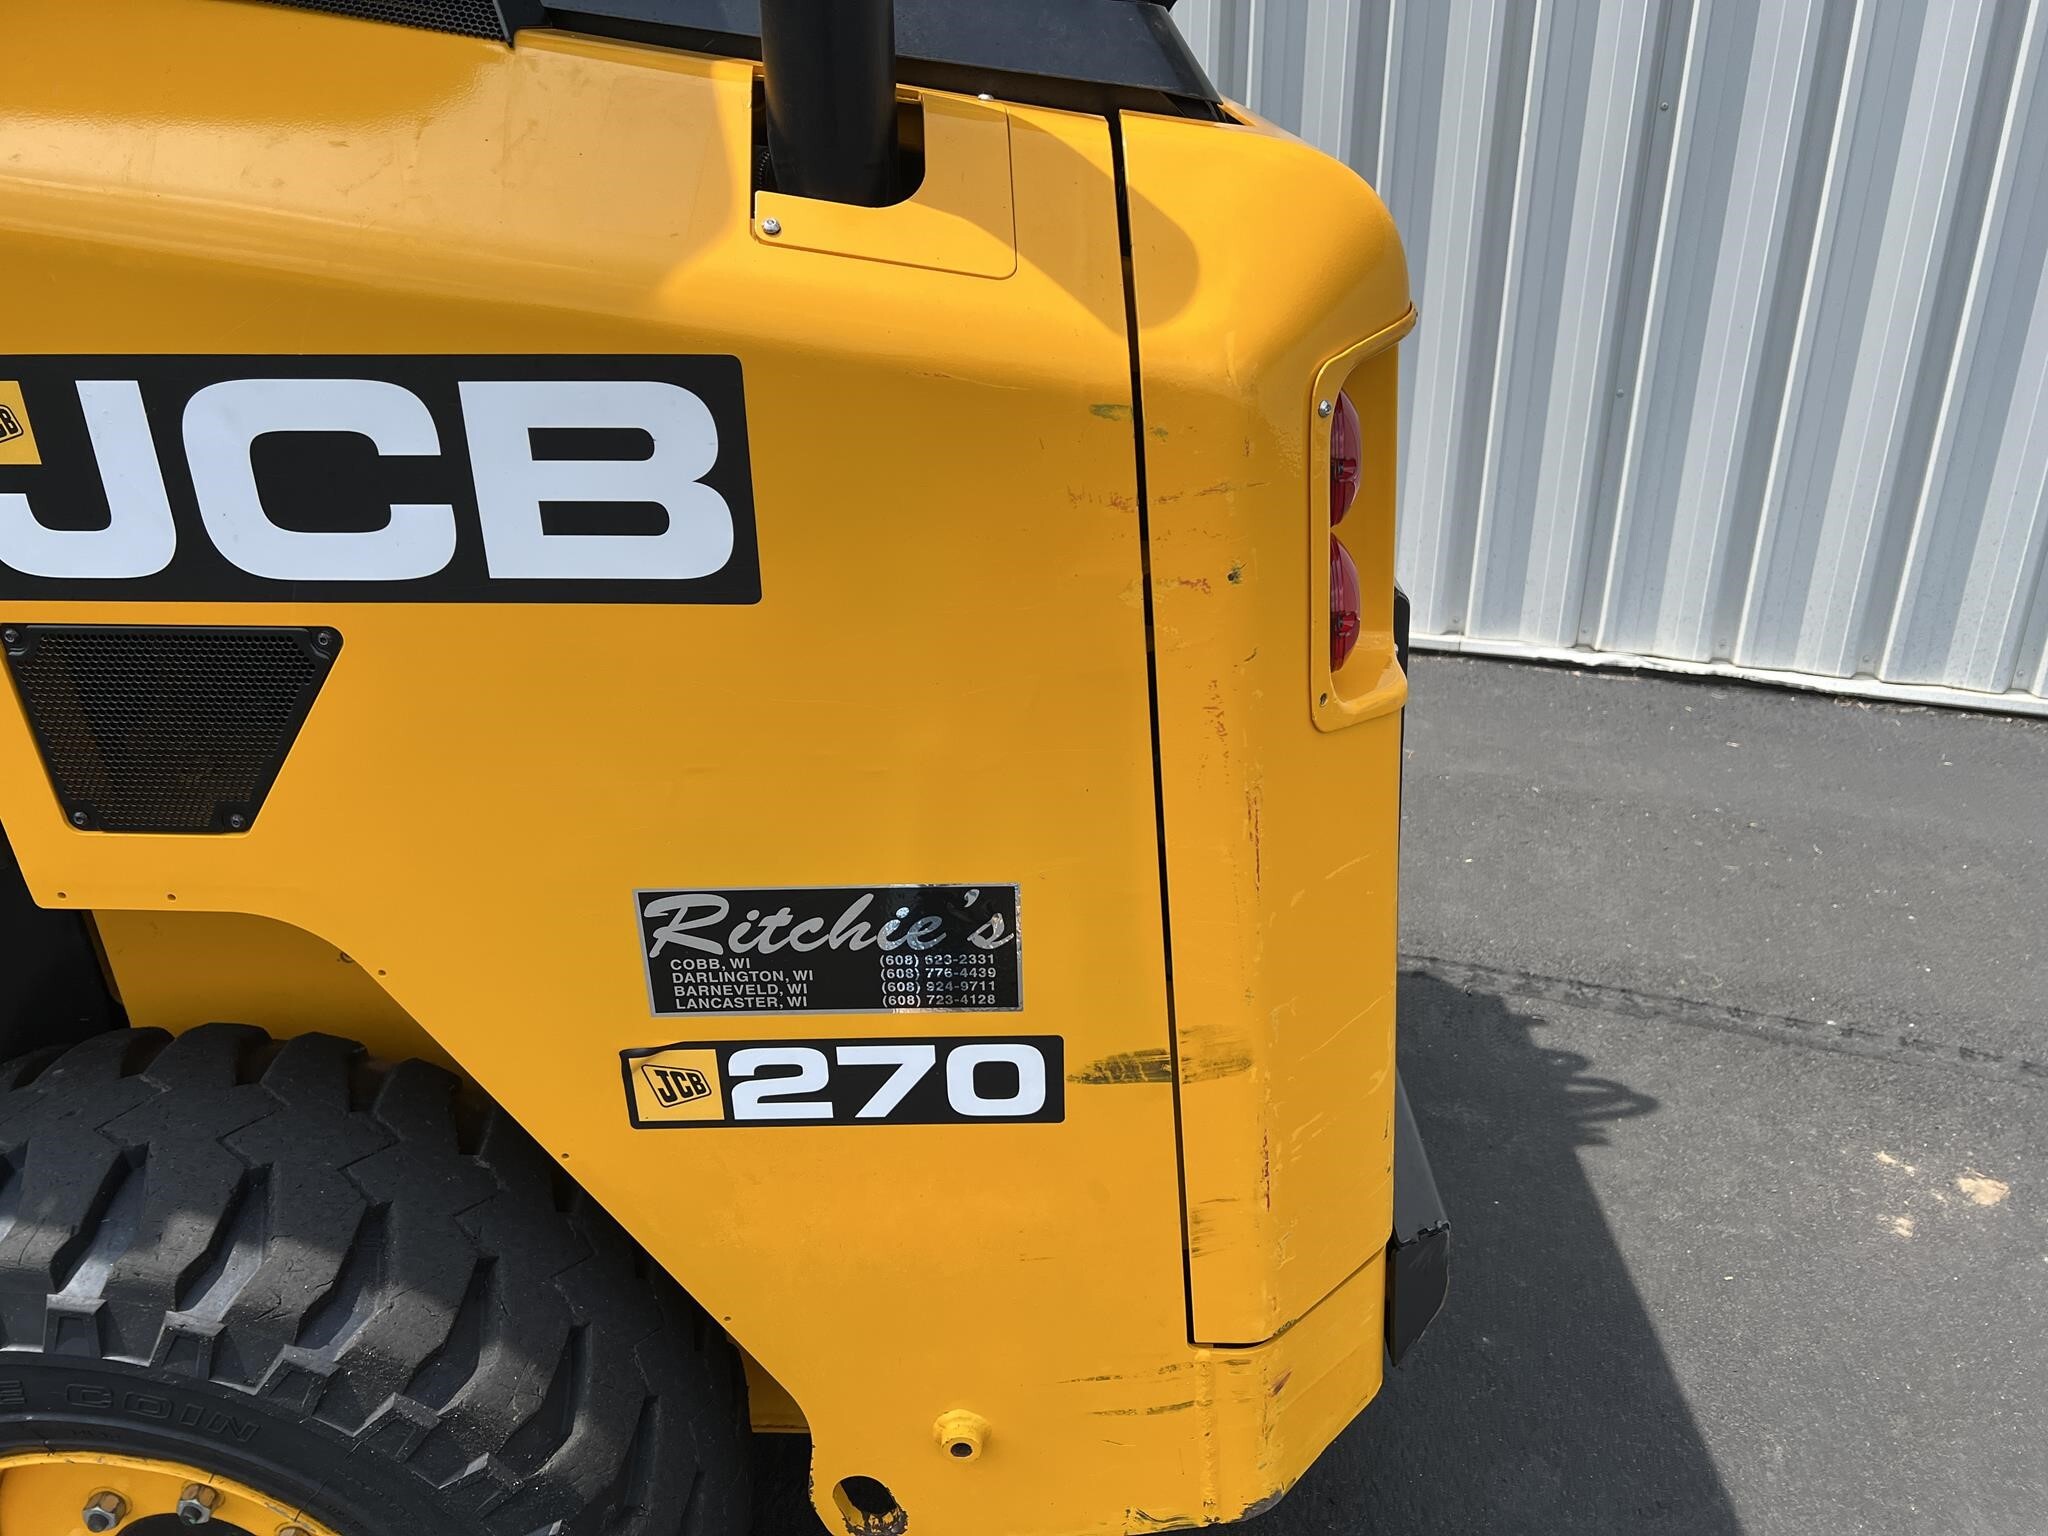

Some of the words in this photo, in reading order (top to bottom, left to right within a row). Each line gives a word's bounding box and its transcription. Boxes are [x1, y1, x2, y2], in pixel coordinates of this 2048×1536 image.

[0, 379, 734, 581] JCB
[644, 889, 1015, 958] Ritchie's
[670, 958, 726, 971] COBB,
[730, 958, 751, 969] WI
[879, 954, 919, 968] (608)
[924, 954, 995, 965] 623-2331
[672, 970, 789, 984] DARLINGTON,
[793, 970, 814, 981] WI
[880, 968, 920, 981] (608)
[925, 967, 997, 979] 776-4439
[674, 984, 784, 997] BARNEVELD,
[787, 984, 808, 995] WI
[881, 981, 921, 994] (608)
[926, 980, 996, 992] 924-9711
[676, 997, 784, 1009] LANCASTER,
[787, 997, 808, 1007] WI
[882, 995, 921, 1008] (608)
[926, 994, 996, 1005] 723-4128
[652, 1069, 708, 1103] JCB
[728, 1044, 1046, 1120] 270
[66, 1384, 260, 1441] COIN
